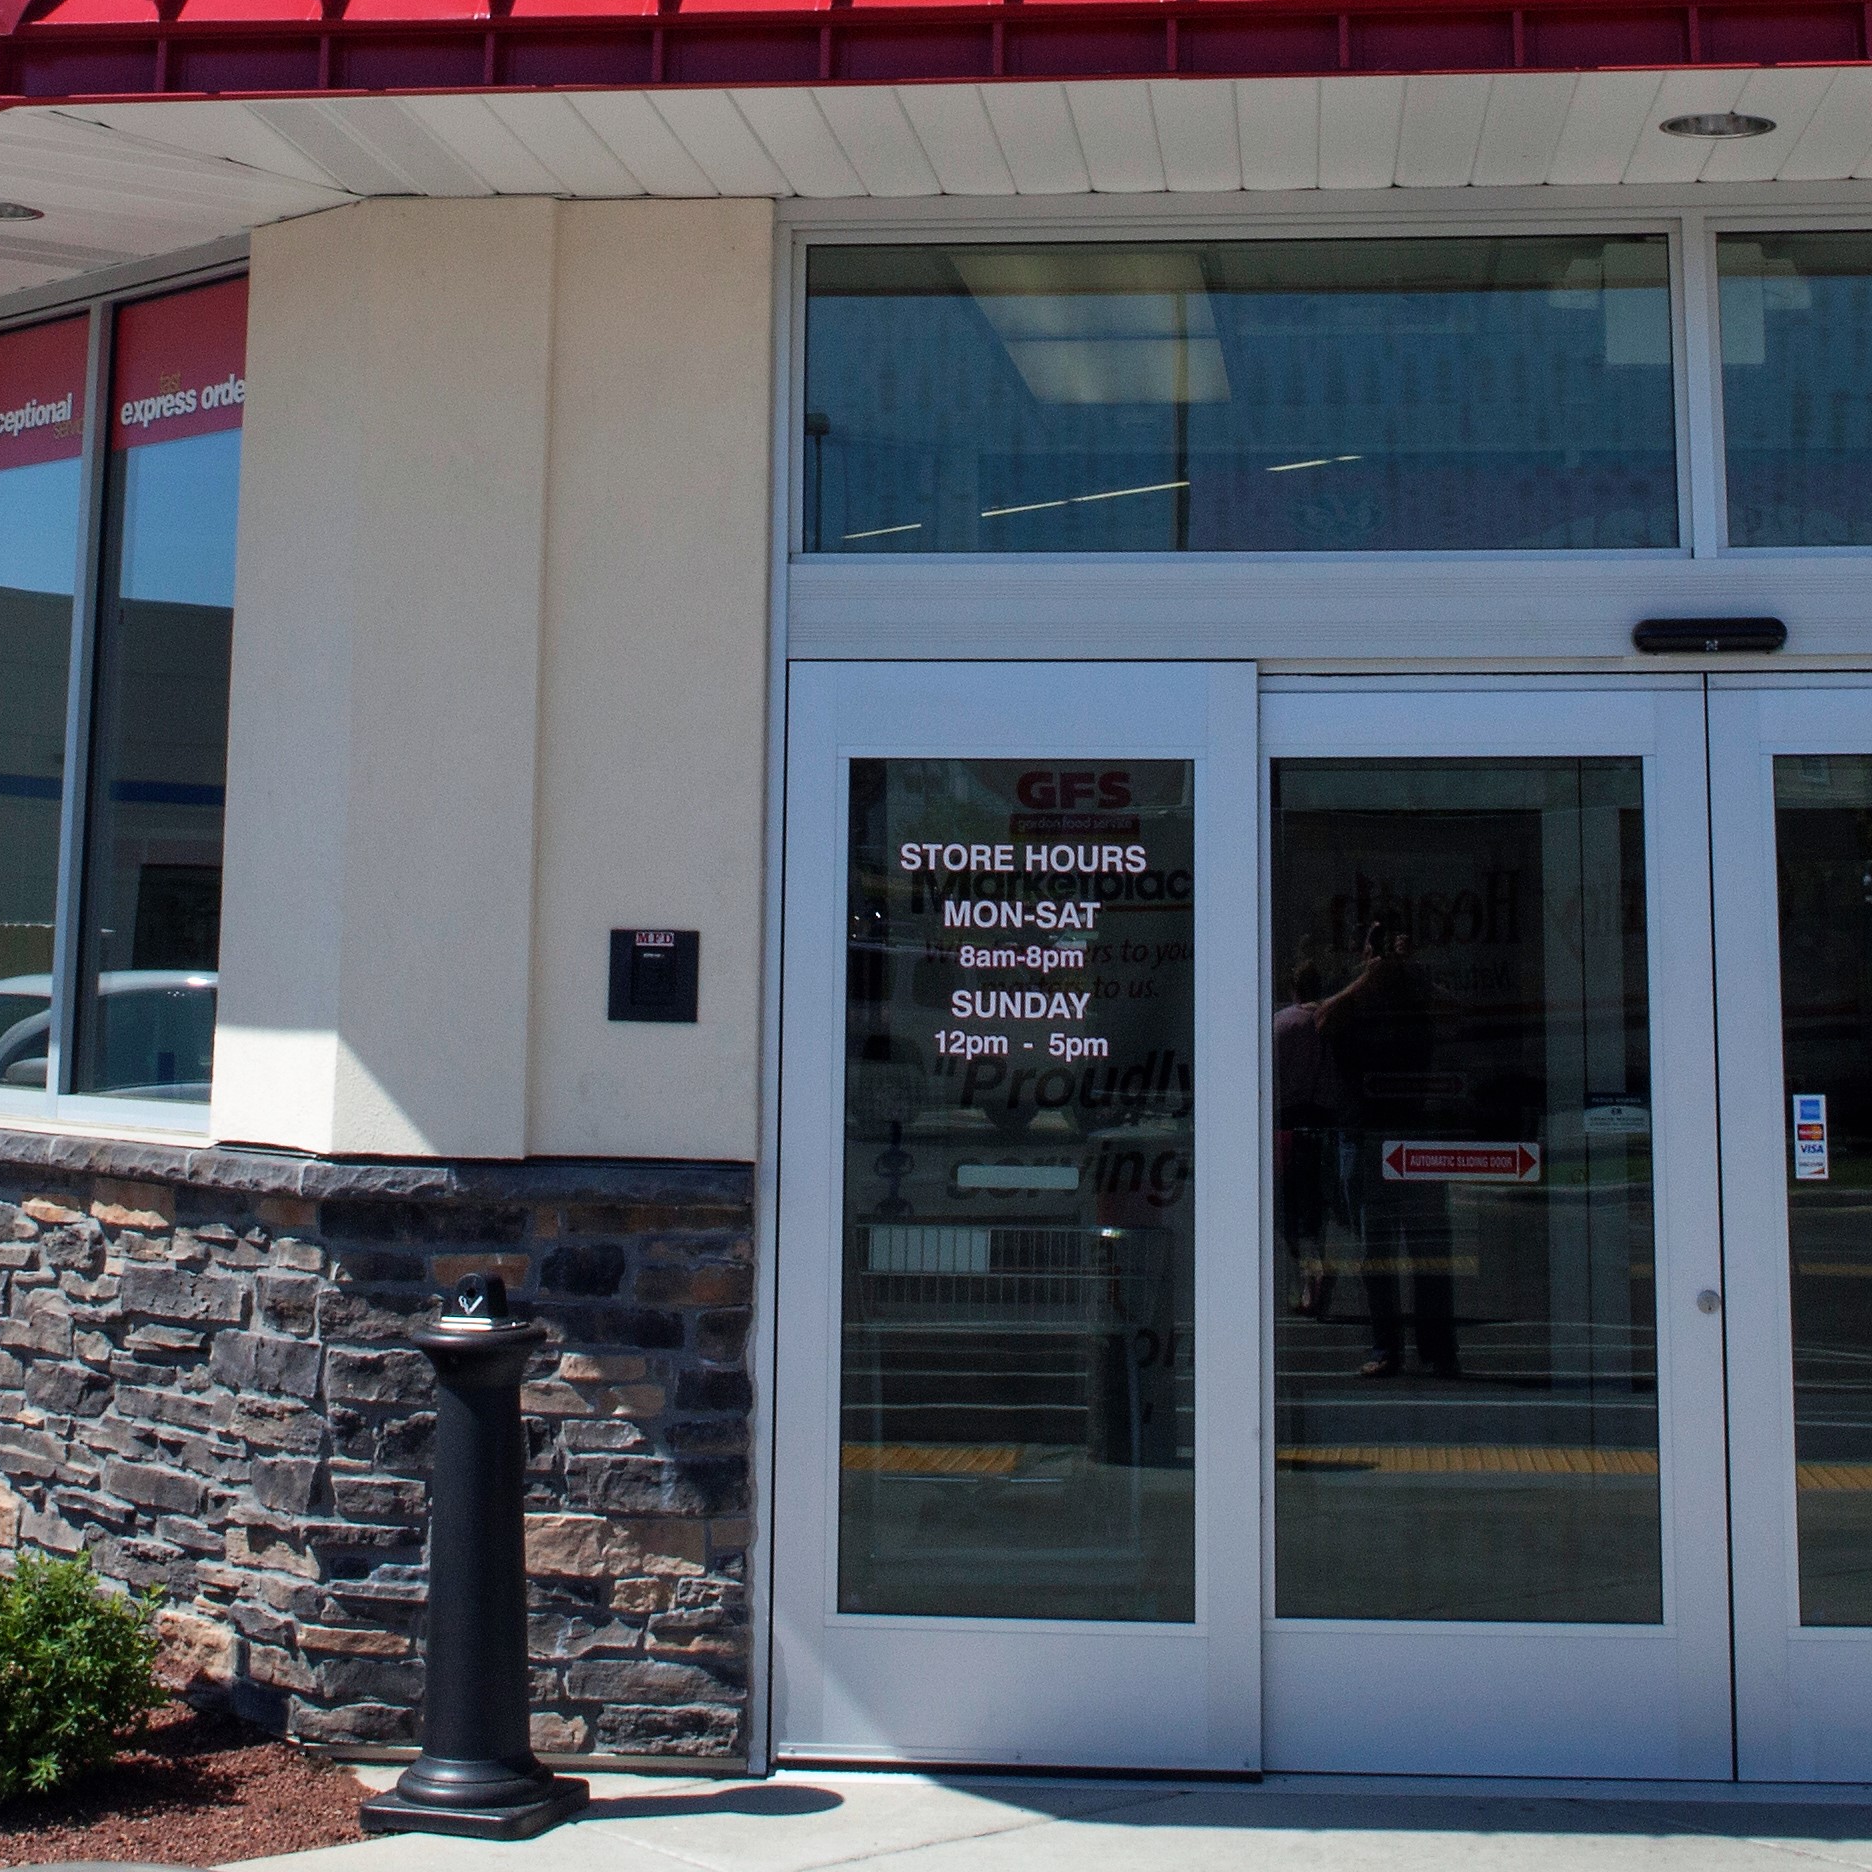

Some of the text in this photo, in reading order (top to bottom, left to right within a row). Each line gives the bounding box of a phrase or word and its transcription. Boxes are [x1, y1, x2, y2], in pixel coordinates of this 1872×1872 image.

[121, 374, 245, 427] express orde
[1017, 771, 1133, 809] GFS
[900, 842, 1147, 873] STORE HOURS
[910, 869, 1192, 914] Marketplac
[944, 901, 1101, 929] MON-SAT
[960, 945, 1084, 973] 8am-8pm
[951, 990, 1091, 1019] SUNDAY
[935, 1030, 1008, 1060] 12pm
[1048, 1033, 1109, 1062] 5pm
[1410, 1154, 1513, 1168] AUTOMATIC SLIDING DOOR
[1800, 1145, 1824, 1154] VISA
